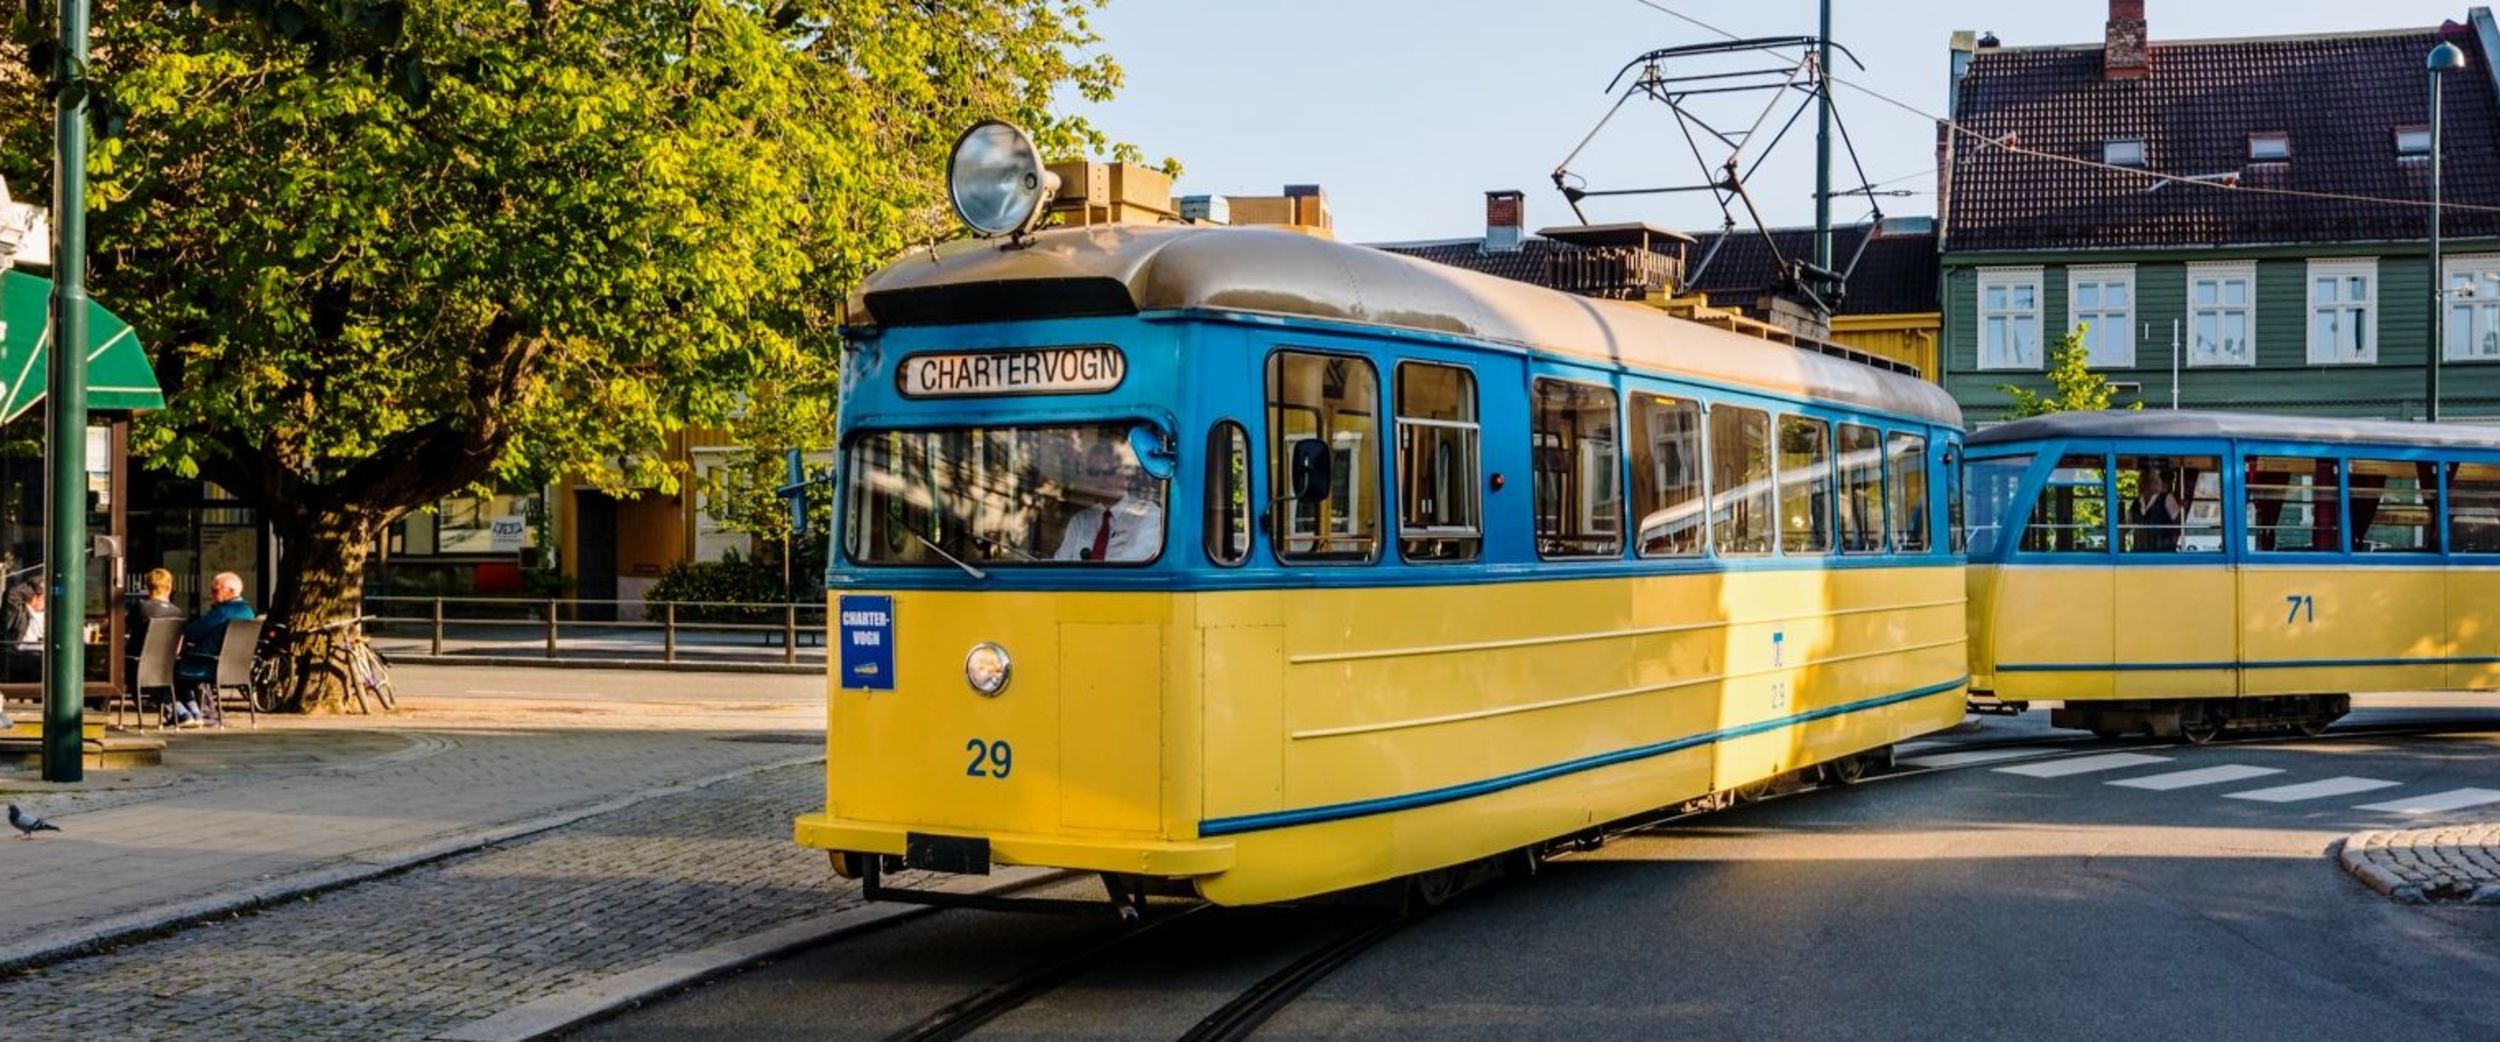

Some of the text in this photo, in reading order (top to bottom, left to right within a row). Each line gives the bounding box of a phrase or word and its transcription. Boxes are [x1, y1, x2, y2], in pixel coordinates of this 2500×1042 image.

[920, 349, 1118, 391] CHARTERVOGN
[842, 611, 890, 626] CHARTER-
[2286, 596, 2314, 623] 71
[852, 631, 880, 645] VOGN
[1771, 683, 1785, 709] 29
[966, 739, 1012, 779] 29
